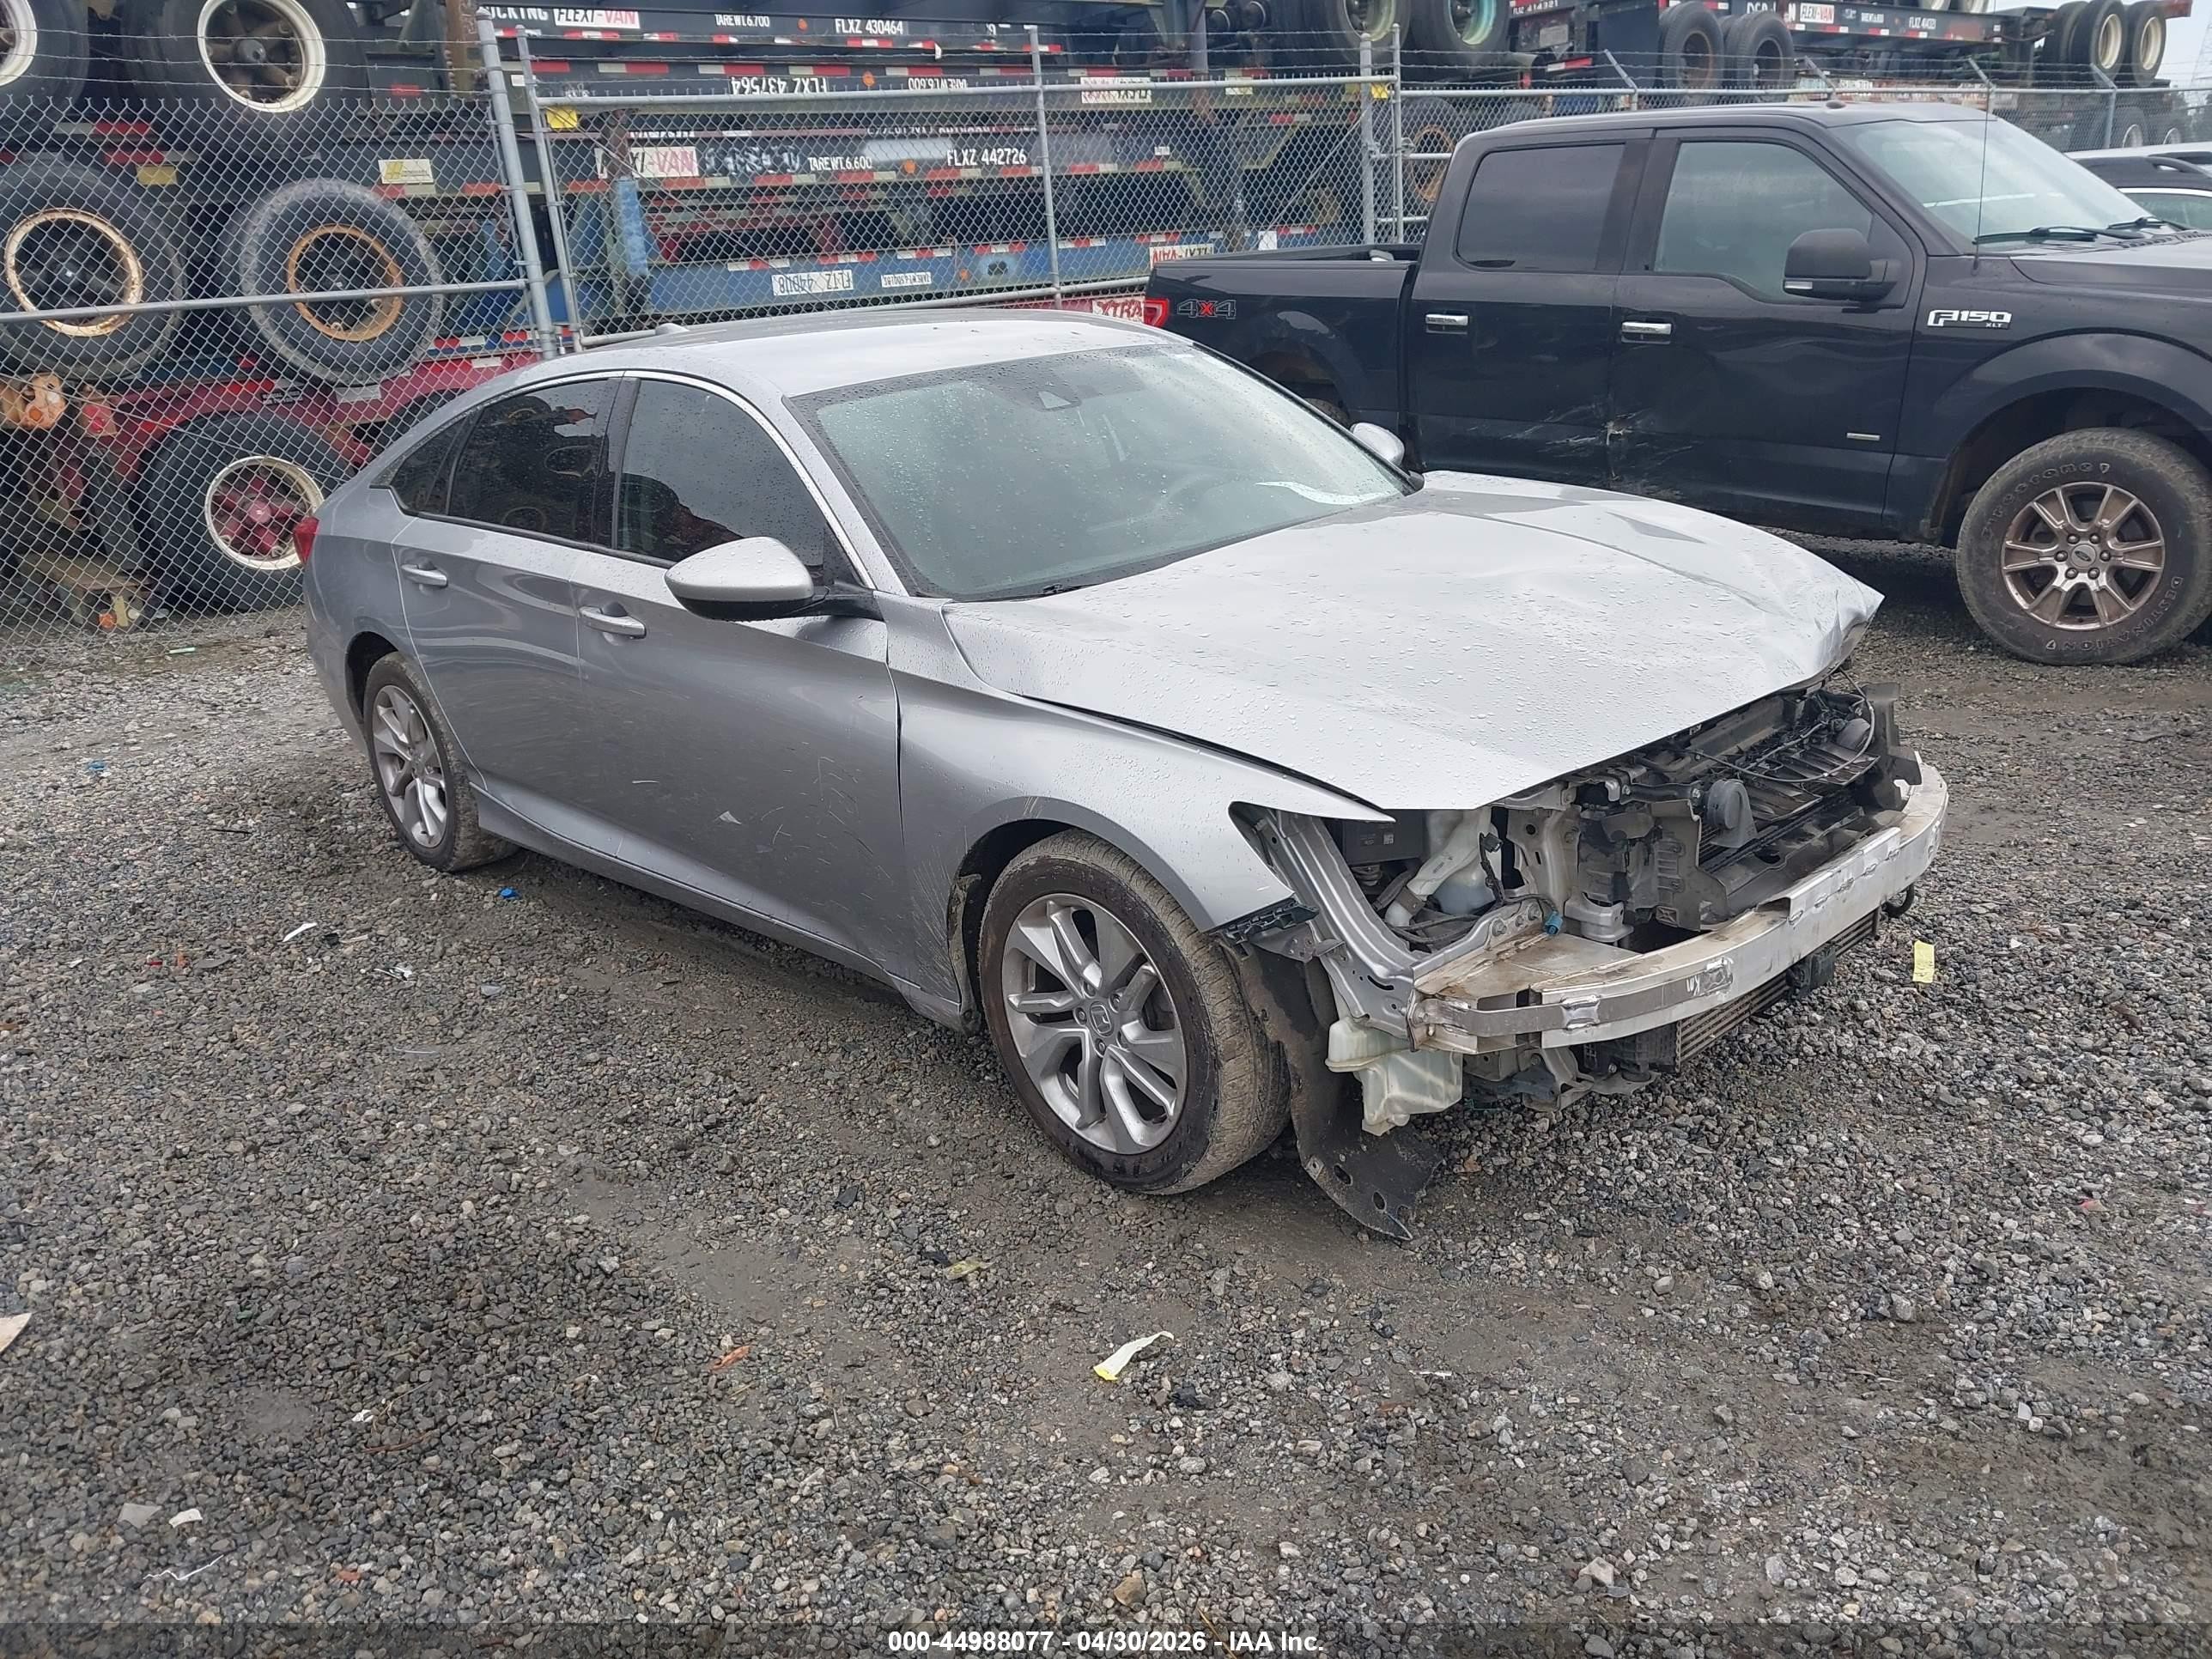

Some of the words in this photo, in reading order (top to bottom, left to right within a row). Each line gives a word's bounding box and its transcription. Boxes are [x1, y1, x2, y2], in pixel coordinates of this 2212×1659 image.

[835, 18, 861, 34] FLXZ
[865, 20, 903, 35] 430464
[947, 148, 977, 167] FLXZ
[981, 148, 1027, 166] 442726
